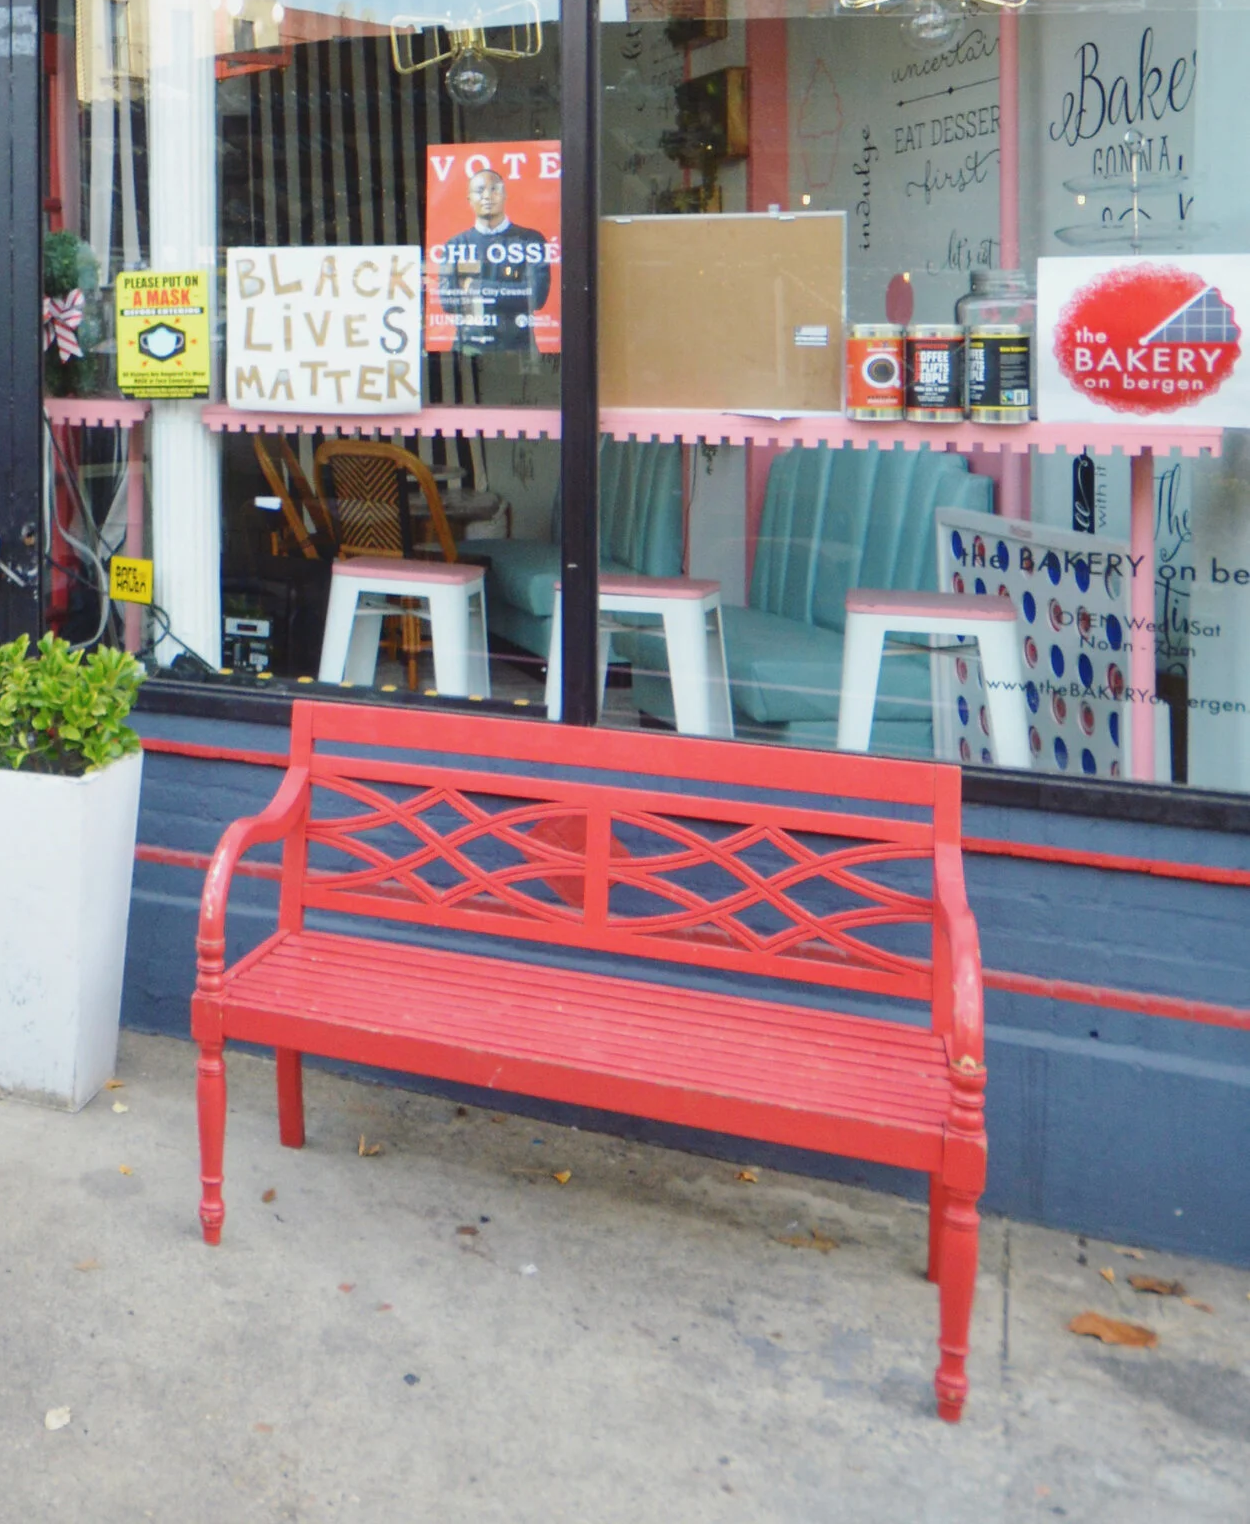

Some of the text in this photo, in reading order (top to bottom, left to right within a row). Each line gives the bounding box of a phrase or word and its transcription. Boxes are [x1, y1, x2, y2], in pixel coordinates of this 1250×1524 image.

[895, 104, 1000, 155] EAT DESSER
[430, 152, 561, 182] VOTE
[906, 149, 996, 205] first
[853, 127, 879, 250] indulge
[430, 237, 561, 264] CHI OSSÉ
[124, 275, 199, 288] PLEASE PUT ON
[235, 254, 416, 300] BLACK
[133, 288, 191, 307] A MASK
[482, 288, 499, 297] City
[500, 287, 532, 296] Council
[430, 314, 463, 326] JUNE
[1075, 326, 1107, 344] the
[1074, 347, 1222, 373] BAKERY
[235, 359, 419, 404] MATTER
[1084, 374, 1204, 394] on bergen
[1095, 465, 1107, 528] with it
[960, 545, 1250, 585] the BAKERY on be
[1190, 621, 1221, 637] Sat
